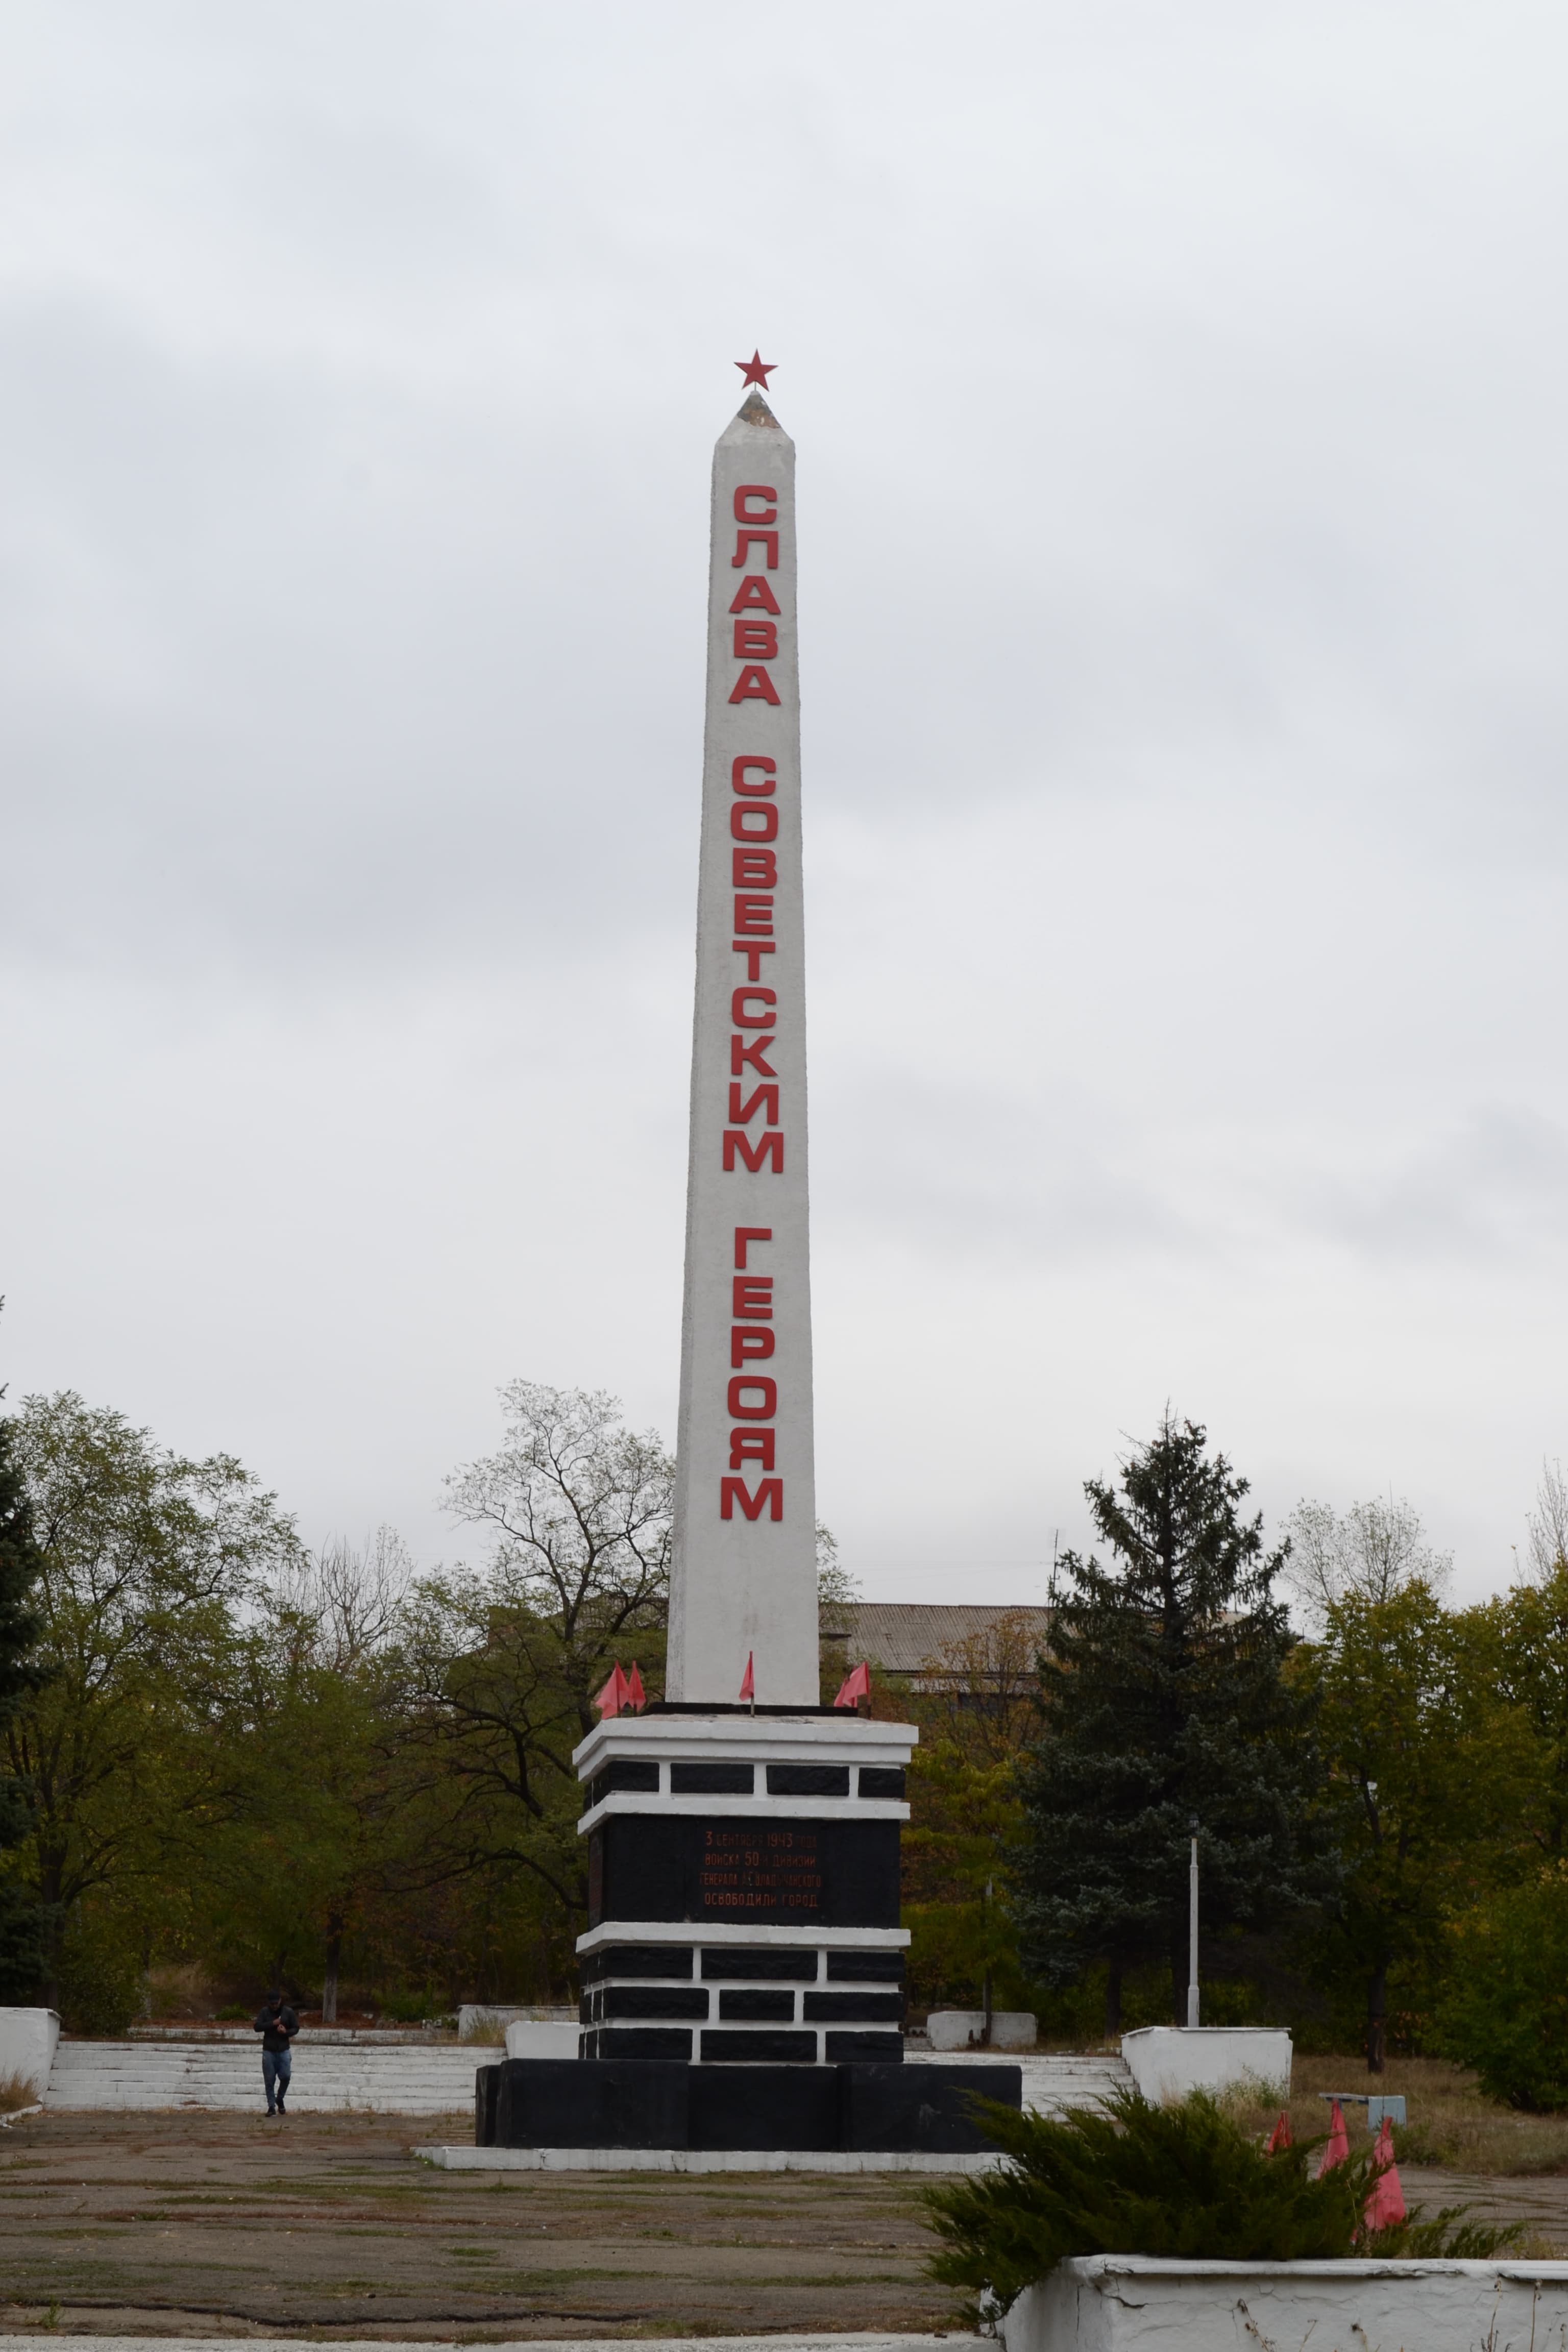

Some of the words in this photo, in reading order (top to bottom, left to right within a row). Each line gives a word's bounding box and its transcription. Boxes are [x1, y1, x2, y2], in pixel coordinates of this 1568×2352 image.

[729, 485, 781, 705] СЛАВА
[723, 755, 784, 1173] СОВЕТСКИМ
[721, 1227, 783, 1522] ГЕРОЯМ
[705, 1831, 713, 1846] 3
[716, 1833, 763, 1846] СЕНТЯБРЯ
[768, 1832, 793, 1848] 1943
[772, 1854, 816, 1868] ДИВИЗИИ
[699, 1872, 738, 1885] ГЕНЕРАЛА
[704, 1893, 776, 1906] ОСВОБОДИЛИ
